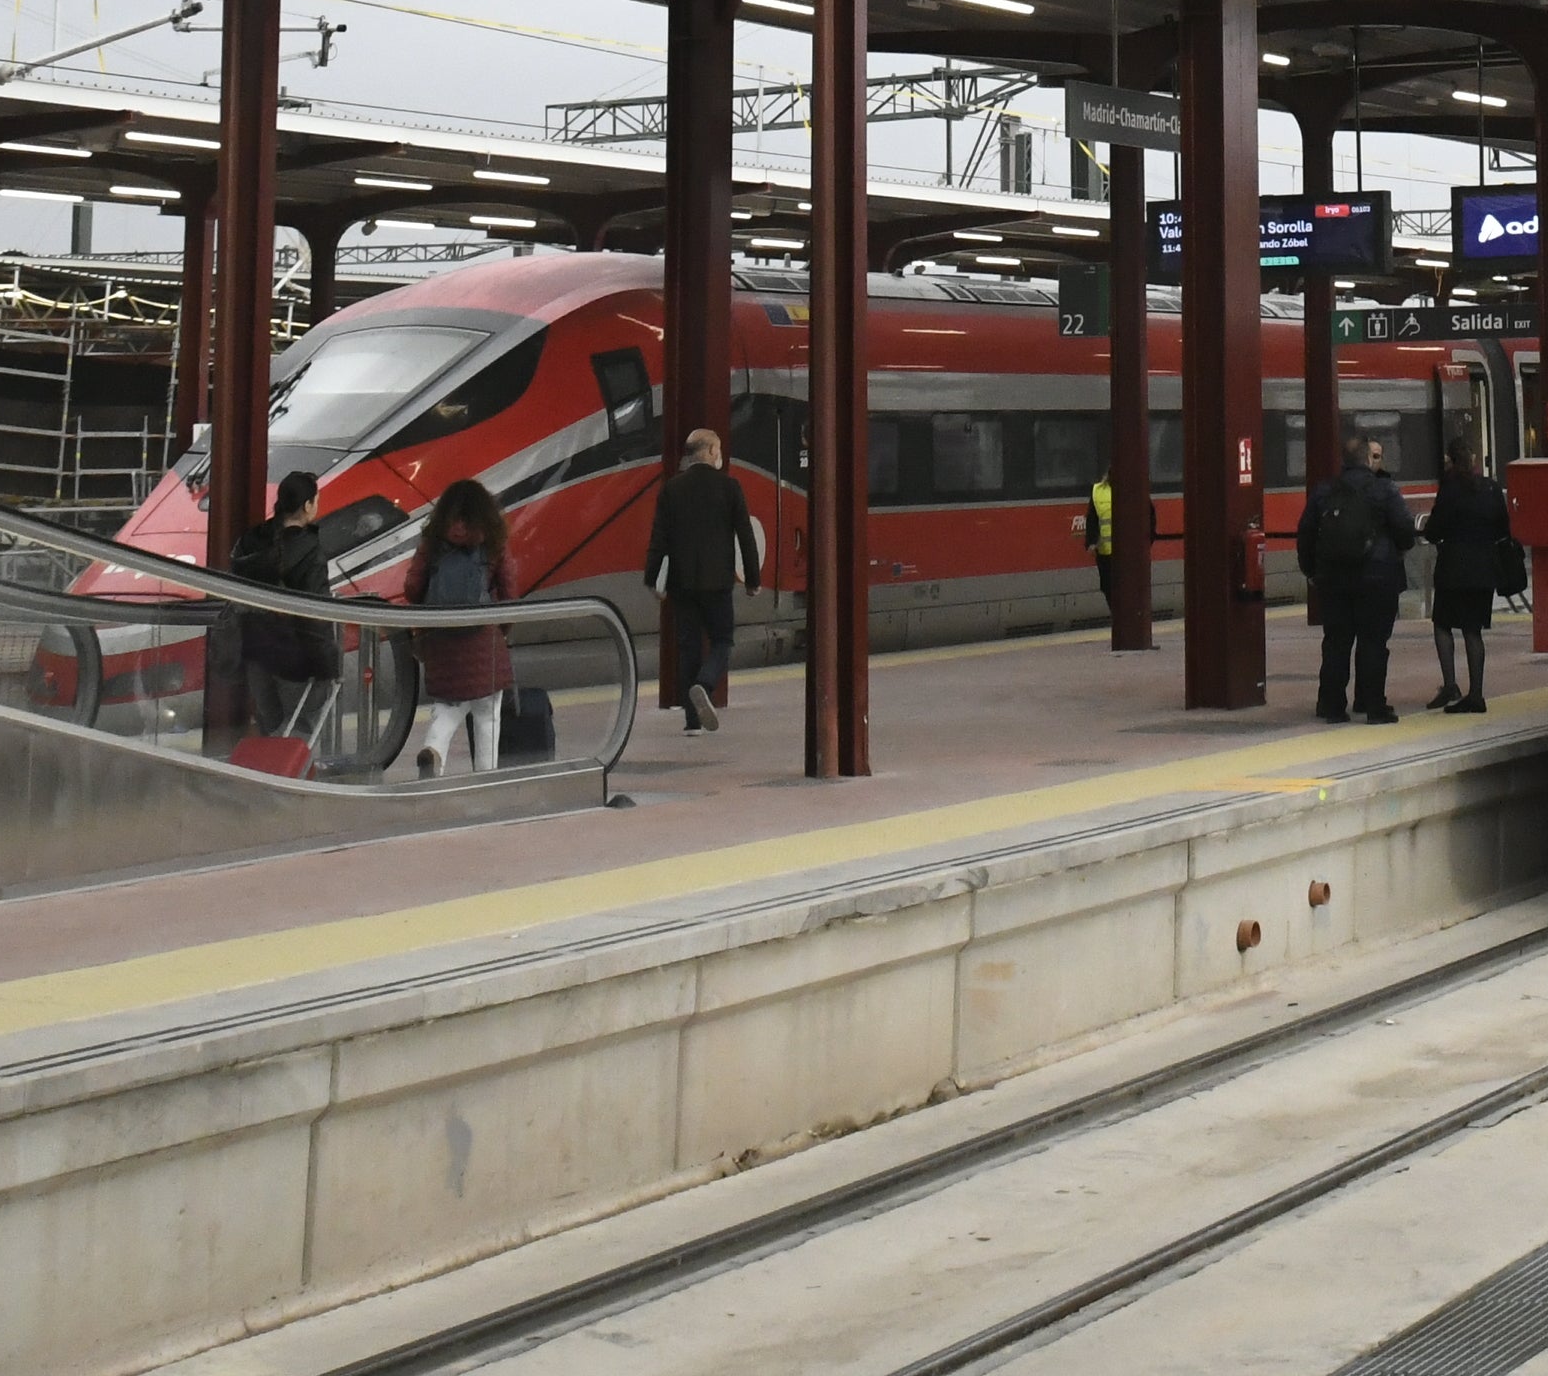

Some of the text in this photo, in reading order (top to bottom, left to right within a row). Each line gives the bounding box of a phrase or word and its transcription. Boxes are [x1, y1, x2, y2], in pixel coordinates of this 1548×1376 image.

[1267, 220, 1313, 234] Sorolla
[1282, 237, 1308, 248] Zóbel
[1062, 314, 1084, 335] 22
[1451, 313, 1531, 331] Salida EXIT
